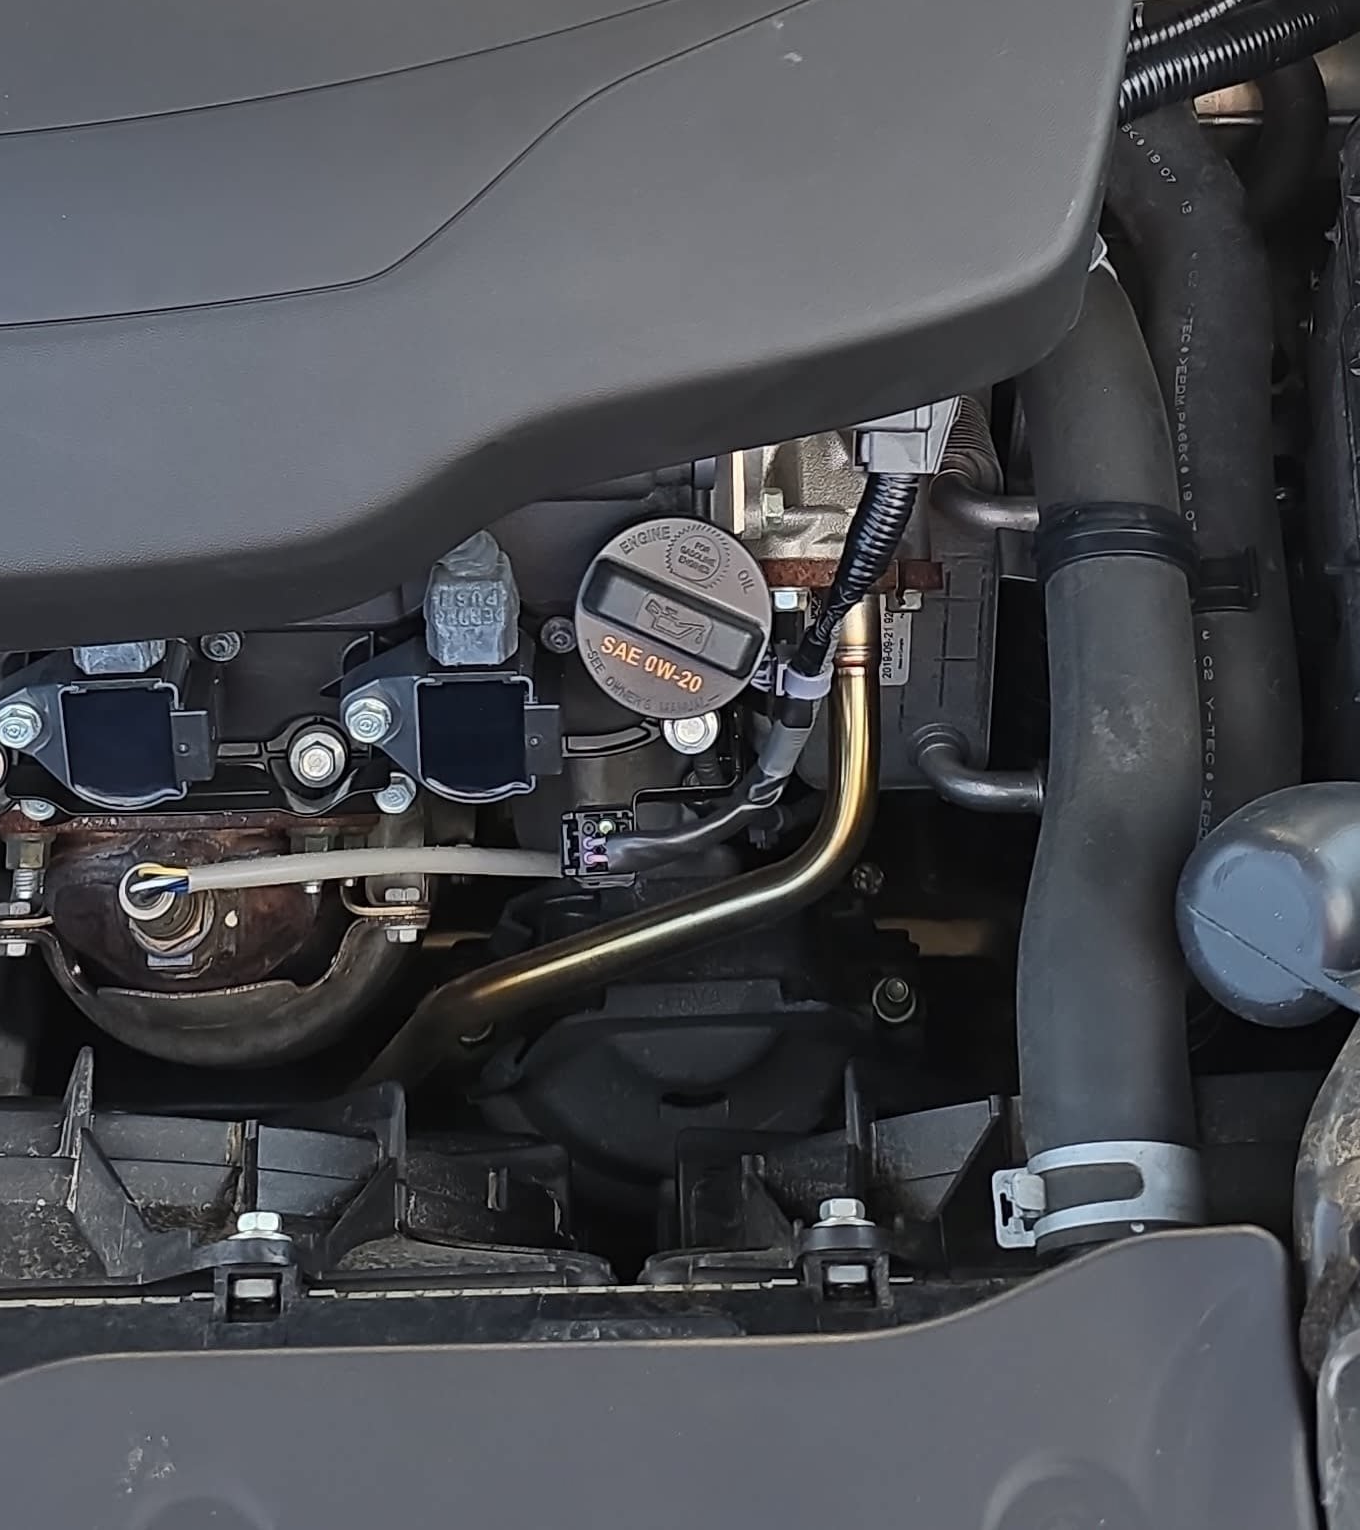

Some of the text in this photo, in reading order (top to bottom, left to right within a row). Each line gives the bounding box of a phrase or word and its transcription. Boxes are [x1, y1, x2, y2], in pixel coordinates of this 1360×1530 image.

[619, 526, 756, 595] ENGINE OIL
[601, 635, 703, 693] SAE 0W-20
